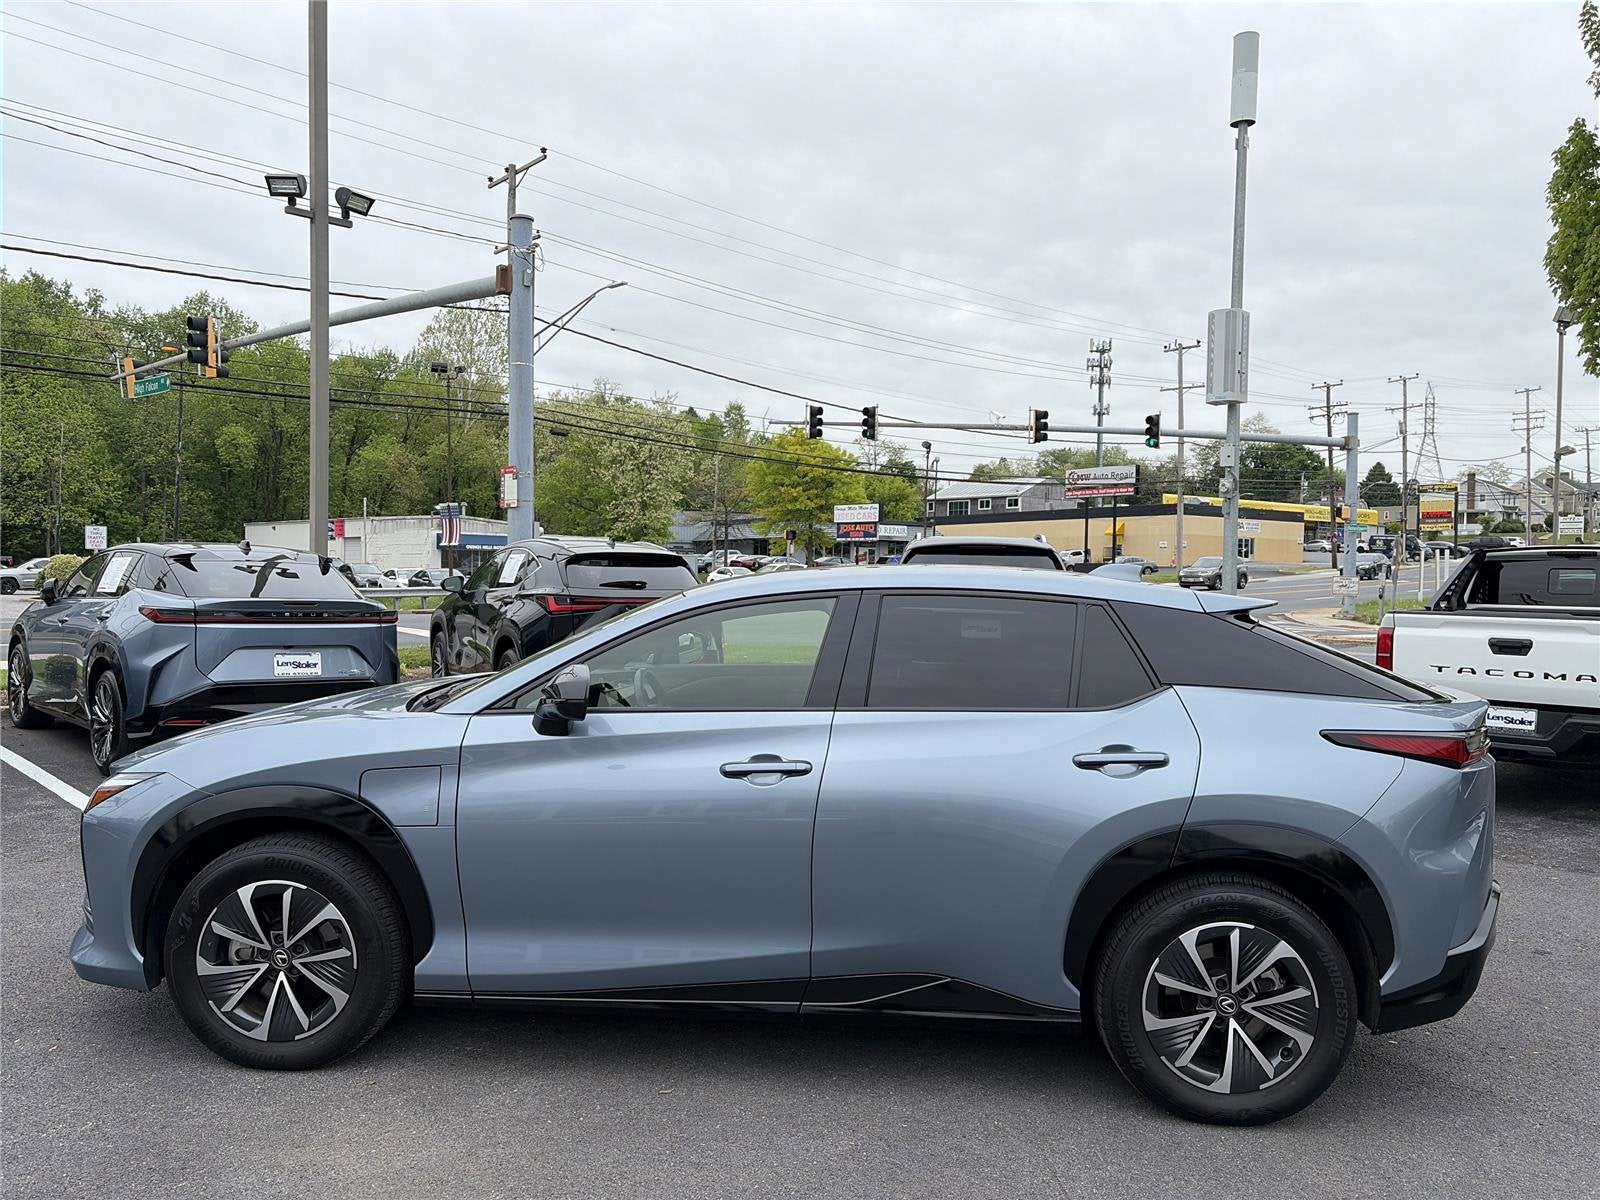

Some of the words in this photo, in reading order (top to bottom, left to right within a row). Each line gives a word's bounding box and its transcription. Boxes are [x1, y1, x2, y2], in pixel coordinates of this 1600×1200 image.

[135, 384, 145, 393] High
[146, 382, 159, 392] Falcon
[1111, 470, 1134, 481] Repair
[836, 512, 855, 520] USED
[856, 512, 878, 520] CARS
[1430, 664, 1597, 682] TACOMA
